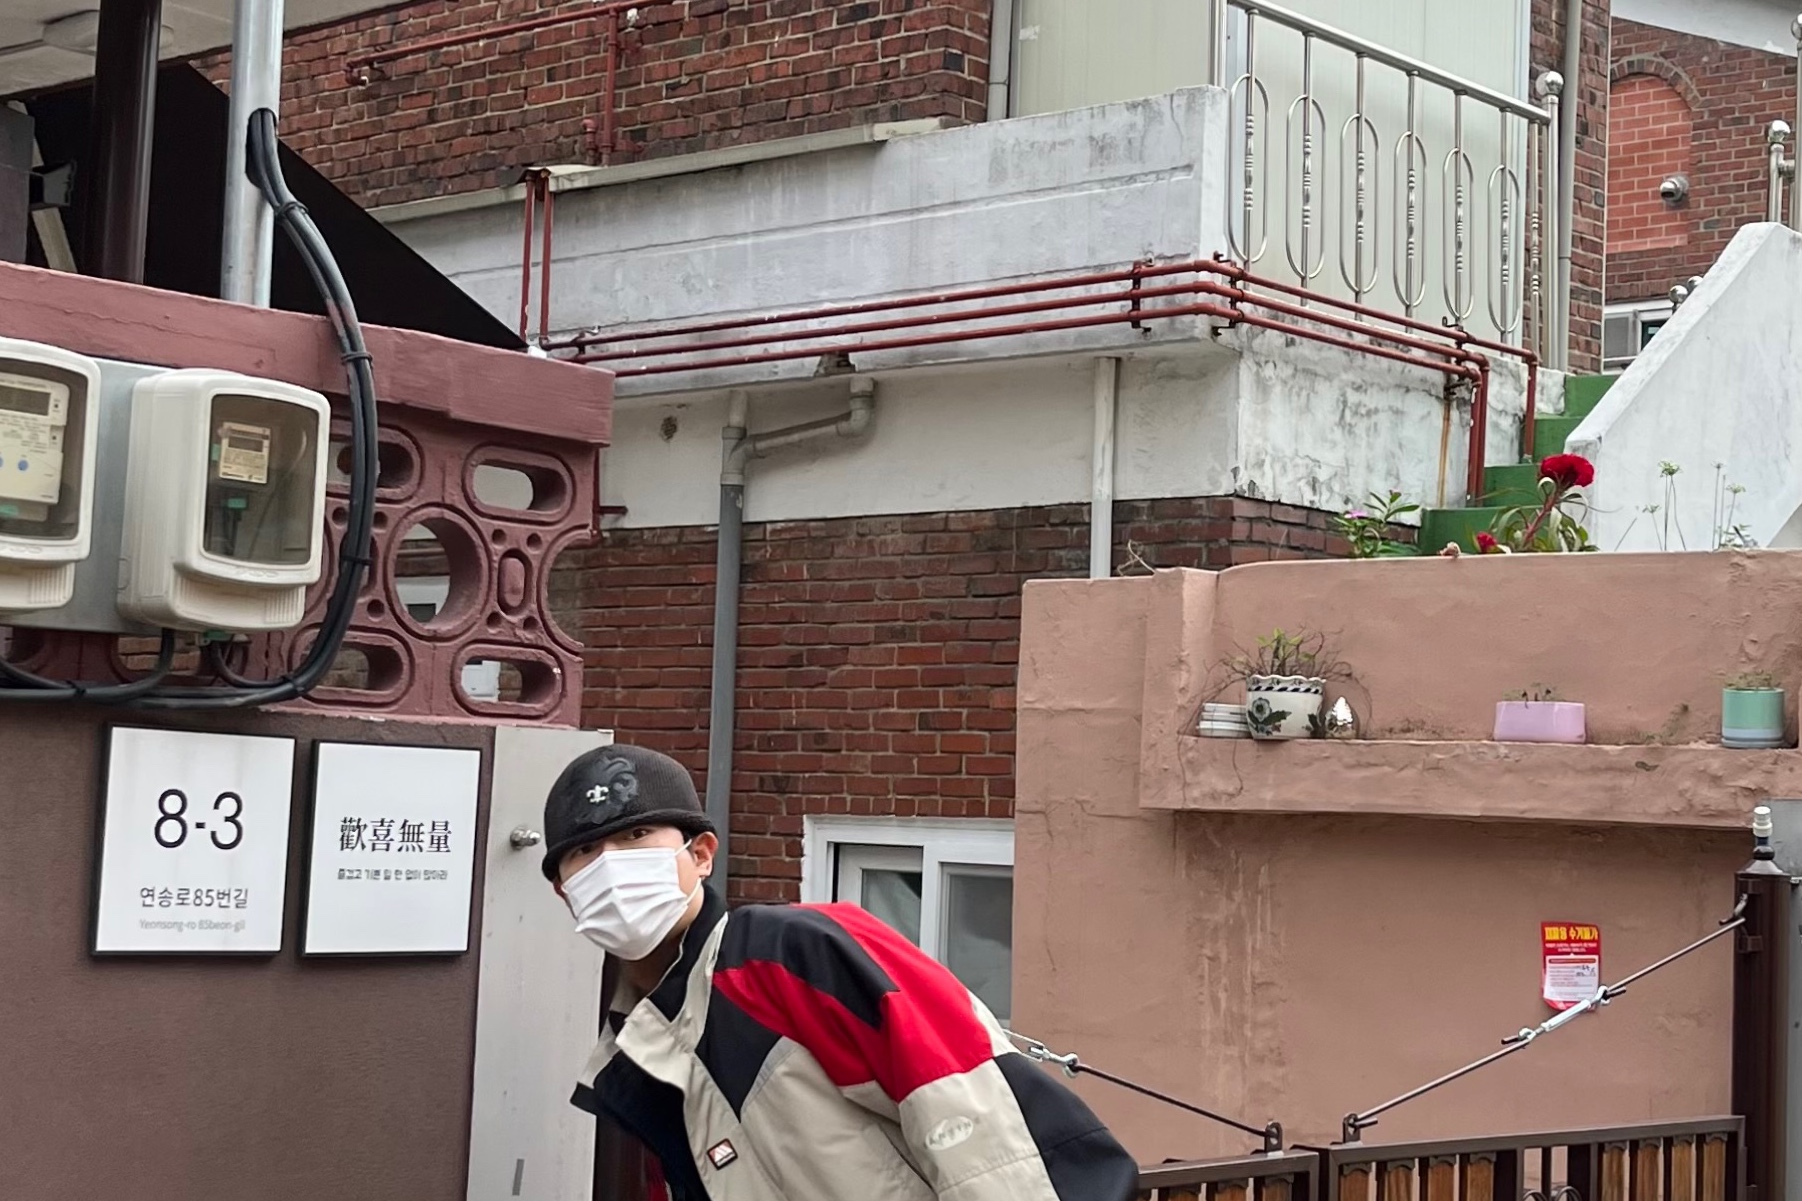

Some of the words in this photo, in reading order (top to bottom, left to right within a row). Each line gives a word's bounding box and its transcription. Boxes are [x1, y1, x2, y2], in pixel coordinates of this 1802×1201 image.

[154, 788, 243, 850] 8-3
[339, 816, 452, 853] 歡喜無量
[140, 886, 248, 909] 연송로85번길
